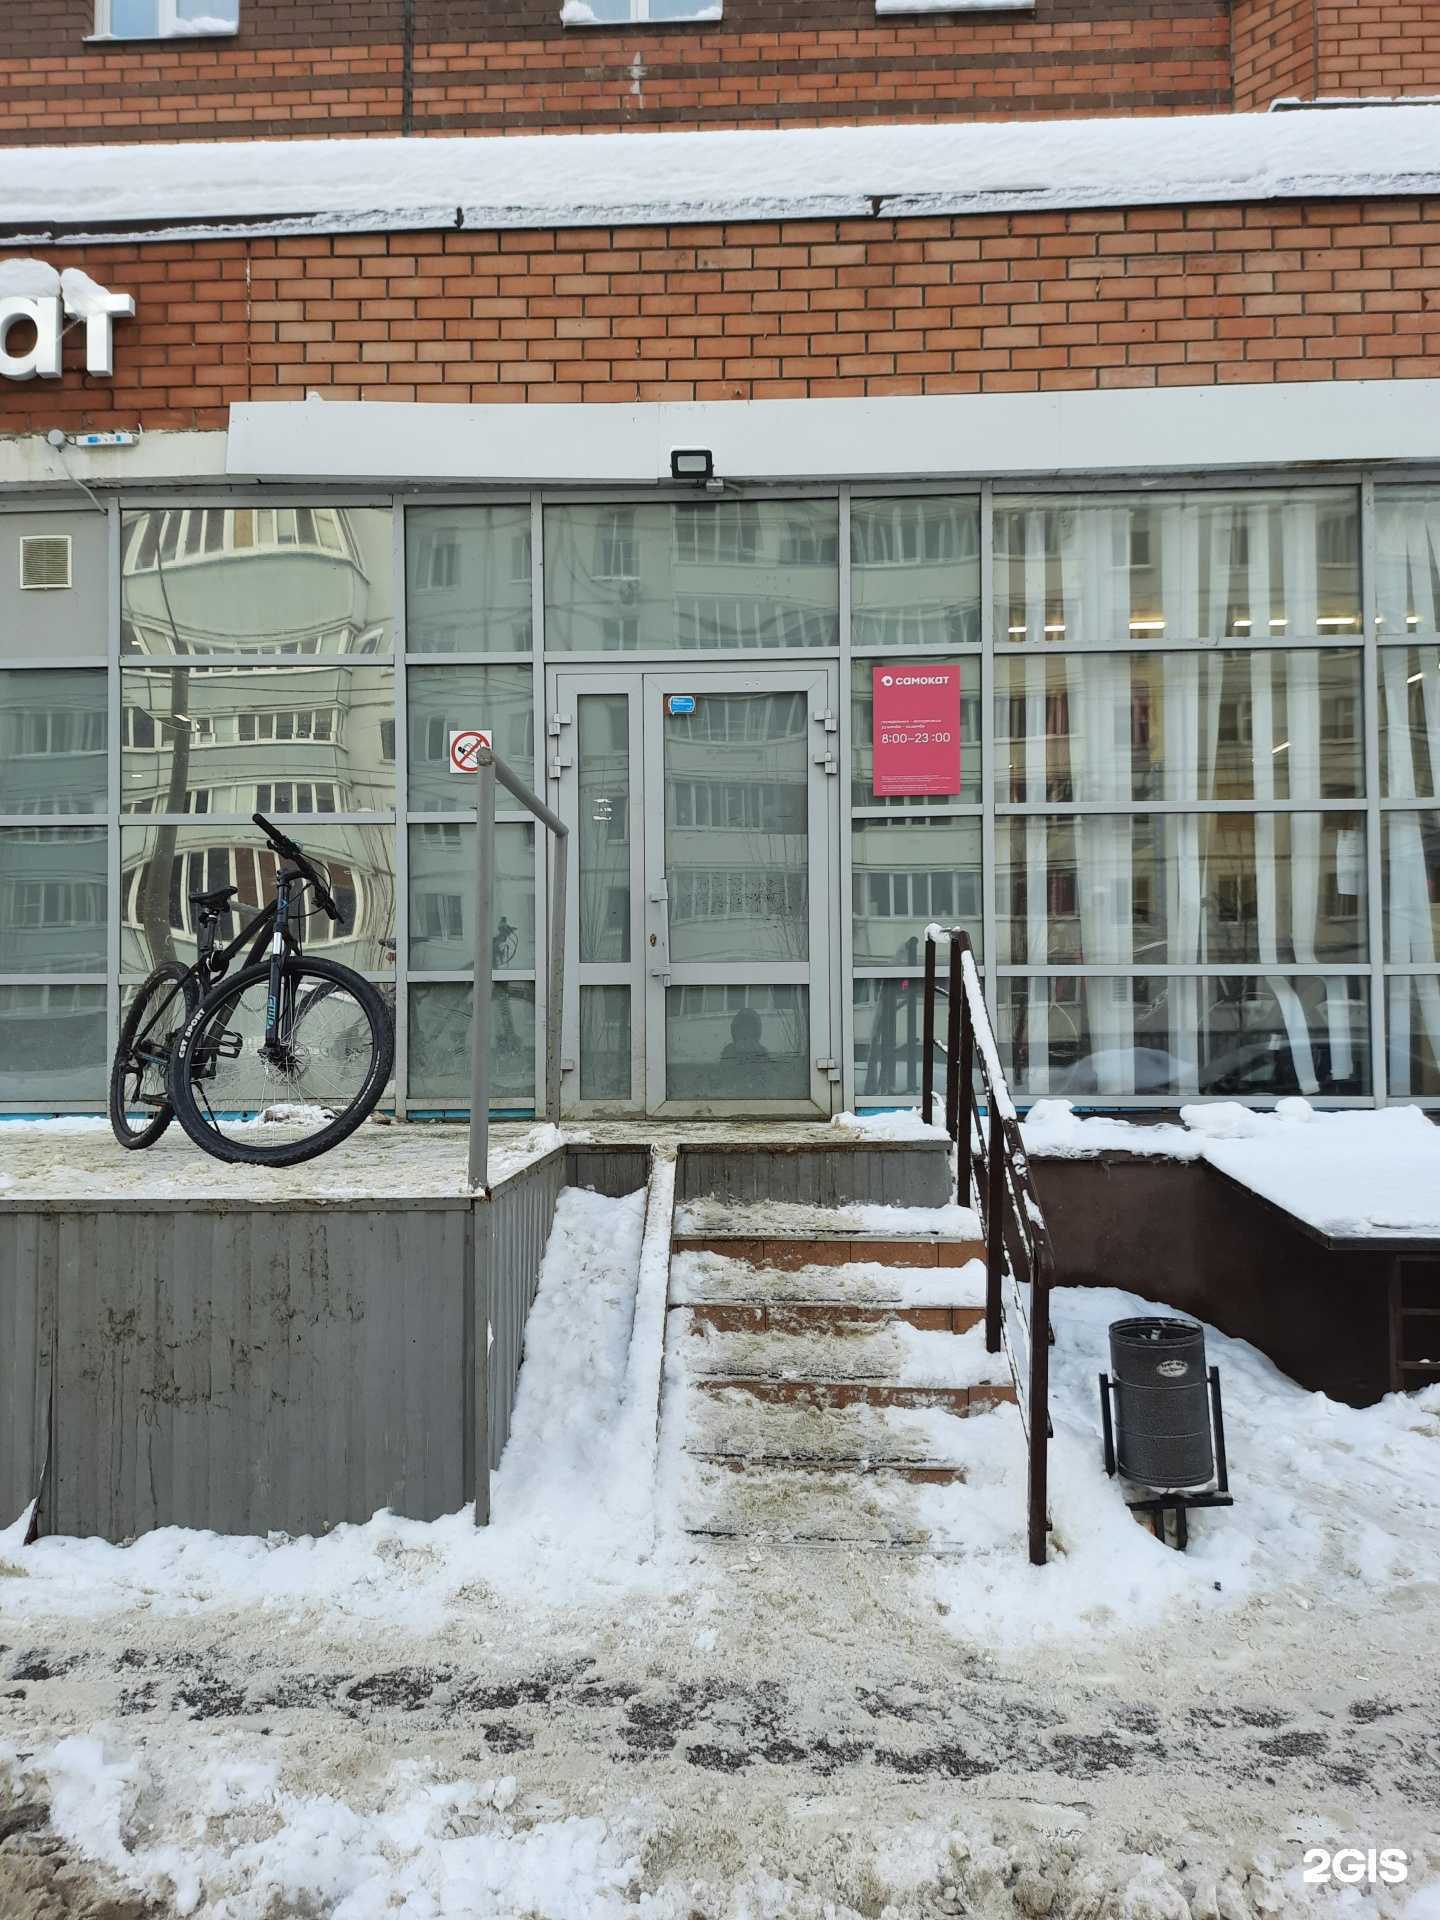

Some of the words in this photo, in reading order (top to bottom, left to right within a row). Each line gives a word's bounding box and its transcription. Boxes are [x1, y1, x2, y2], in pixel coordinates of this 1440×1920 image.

[896, 676, 950, 685] самокат
[178, 1039, 188, 1058] CST
[185, 1008, 206, 1038] SPORT
